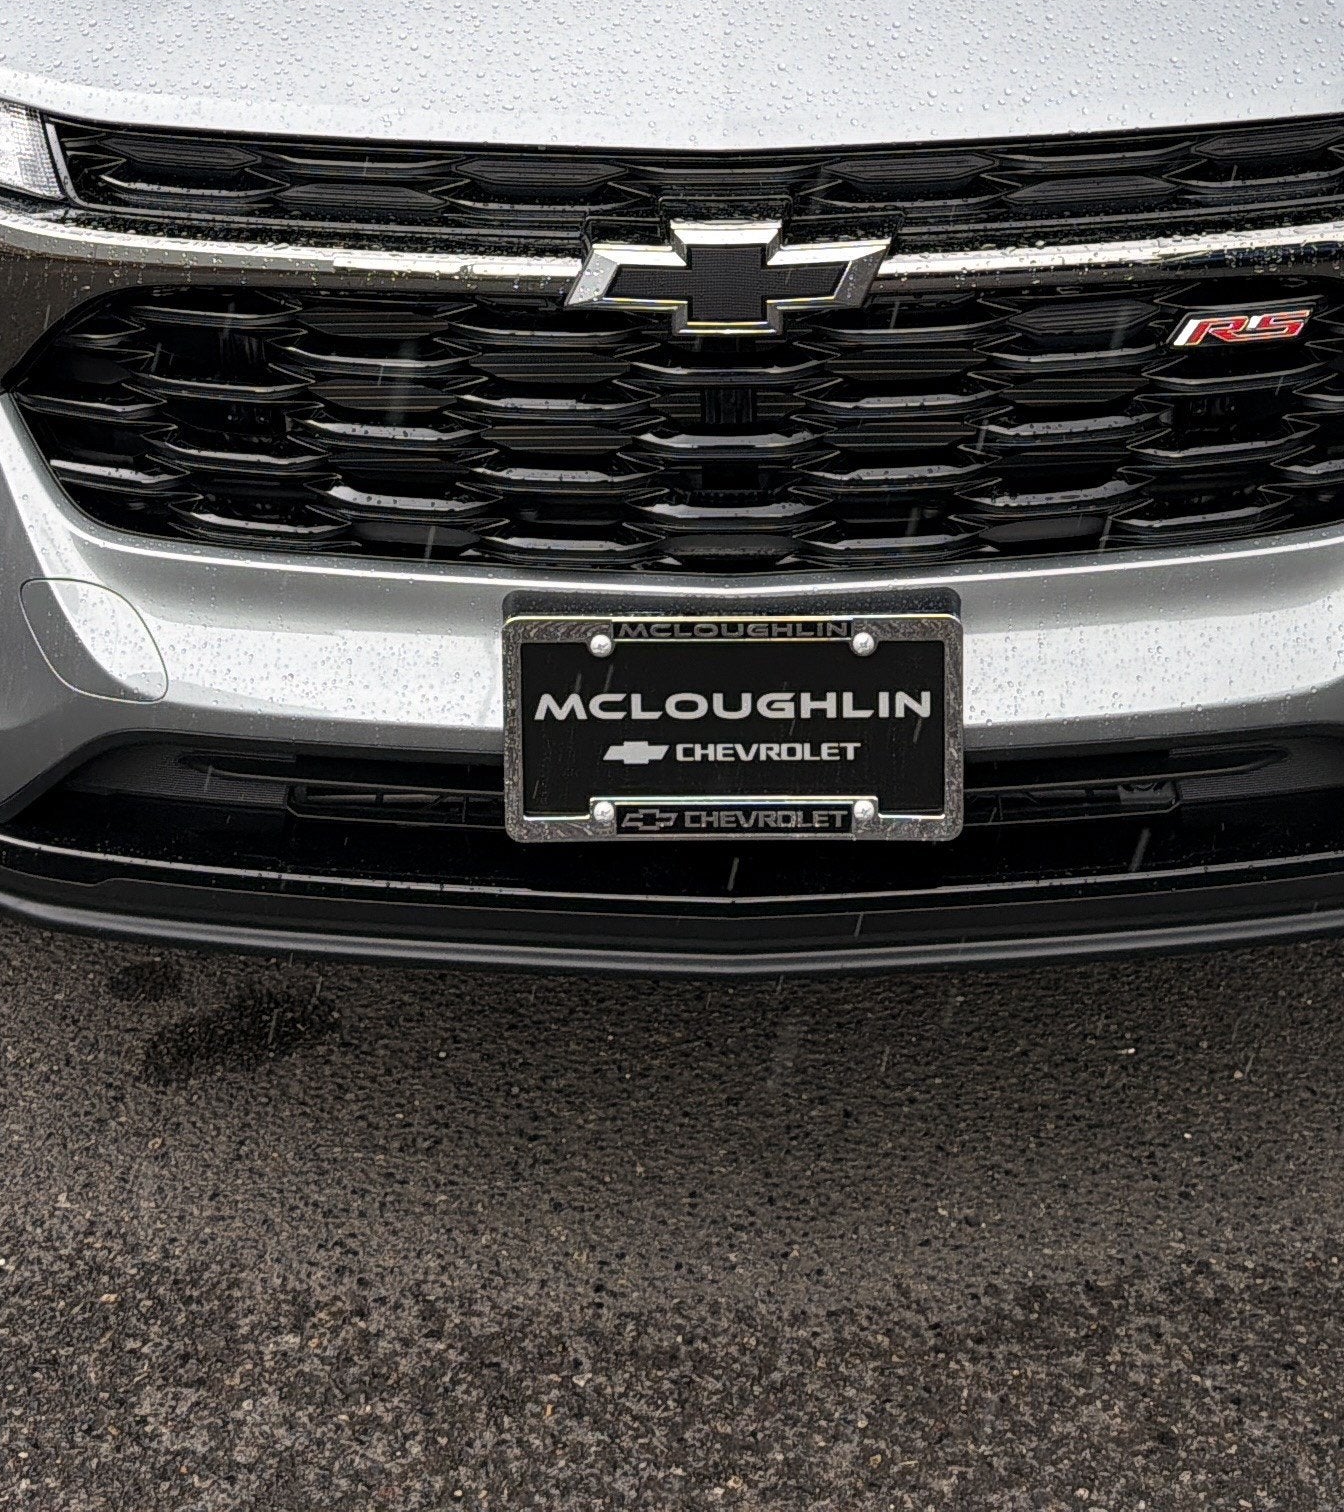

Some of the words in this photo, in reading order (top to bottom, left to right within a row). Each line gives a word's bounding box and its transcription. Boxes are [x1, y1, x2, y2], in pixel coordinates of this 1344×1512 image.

[1174, 310, 1310, 345] RS
[619, 622, 848, 638] MCLOUGHLIN
[535, 691, 931, 720] MCLOUGHLIN
[676, 743, 861, 761] CHEVROLET
[684, 811, 848, 829] CHEVROLET
